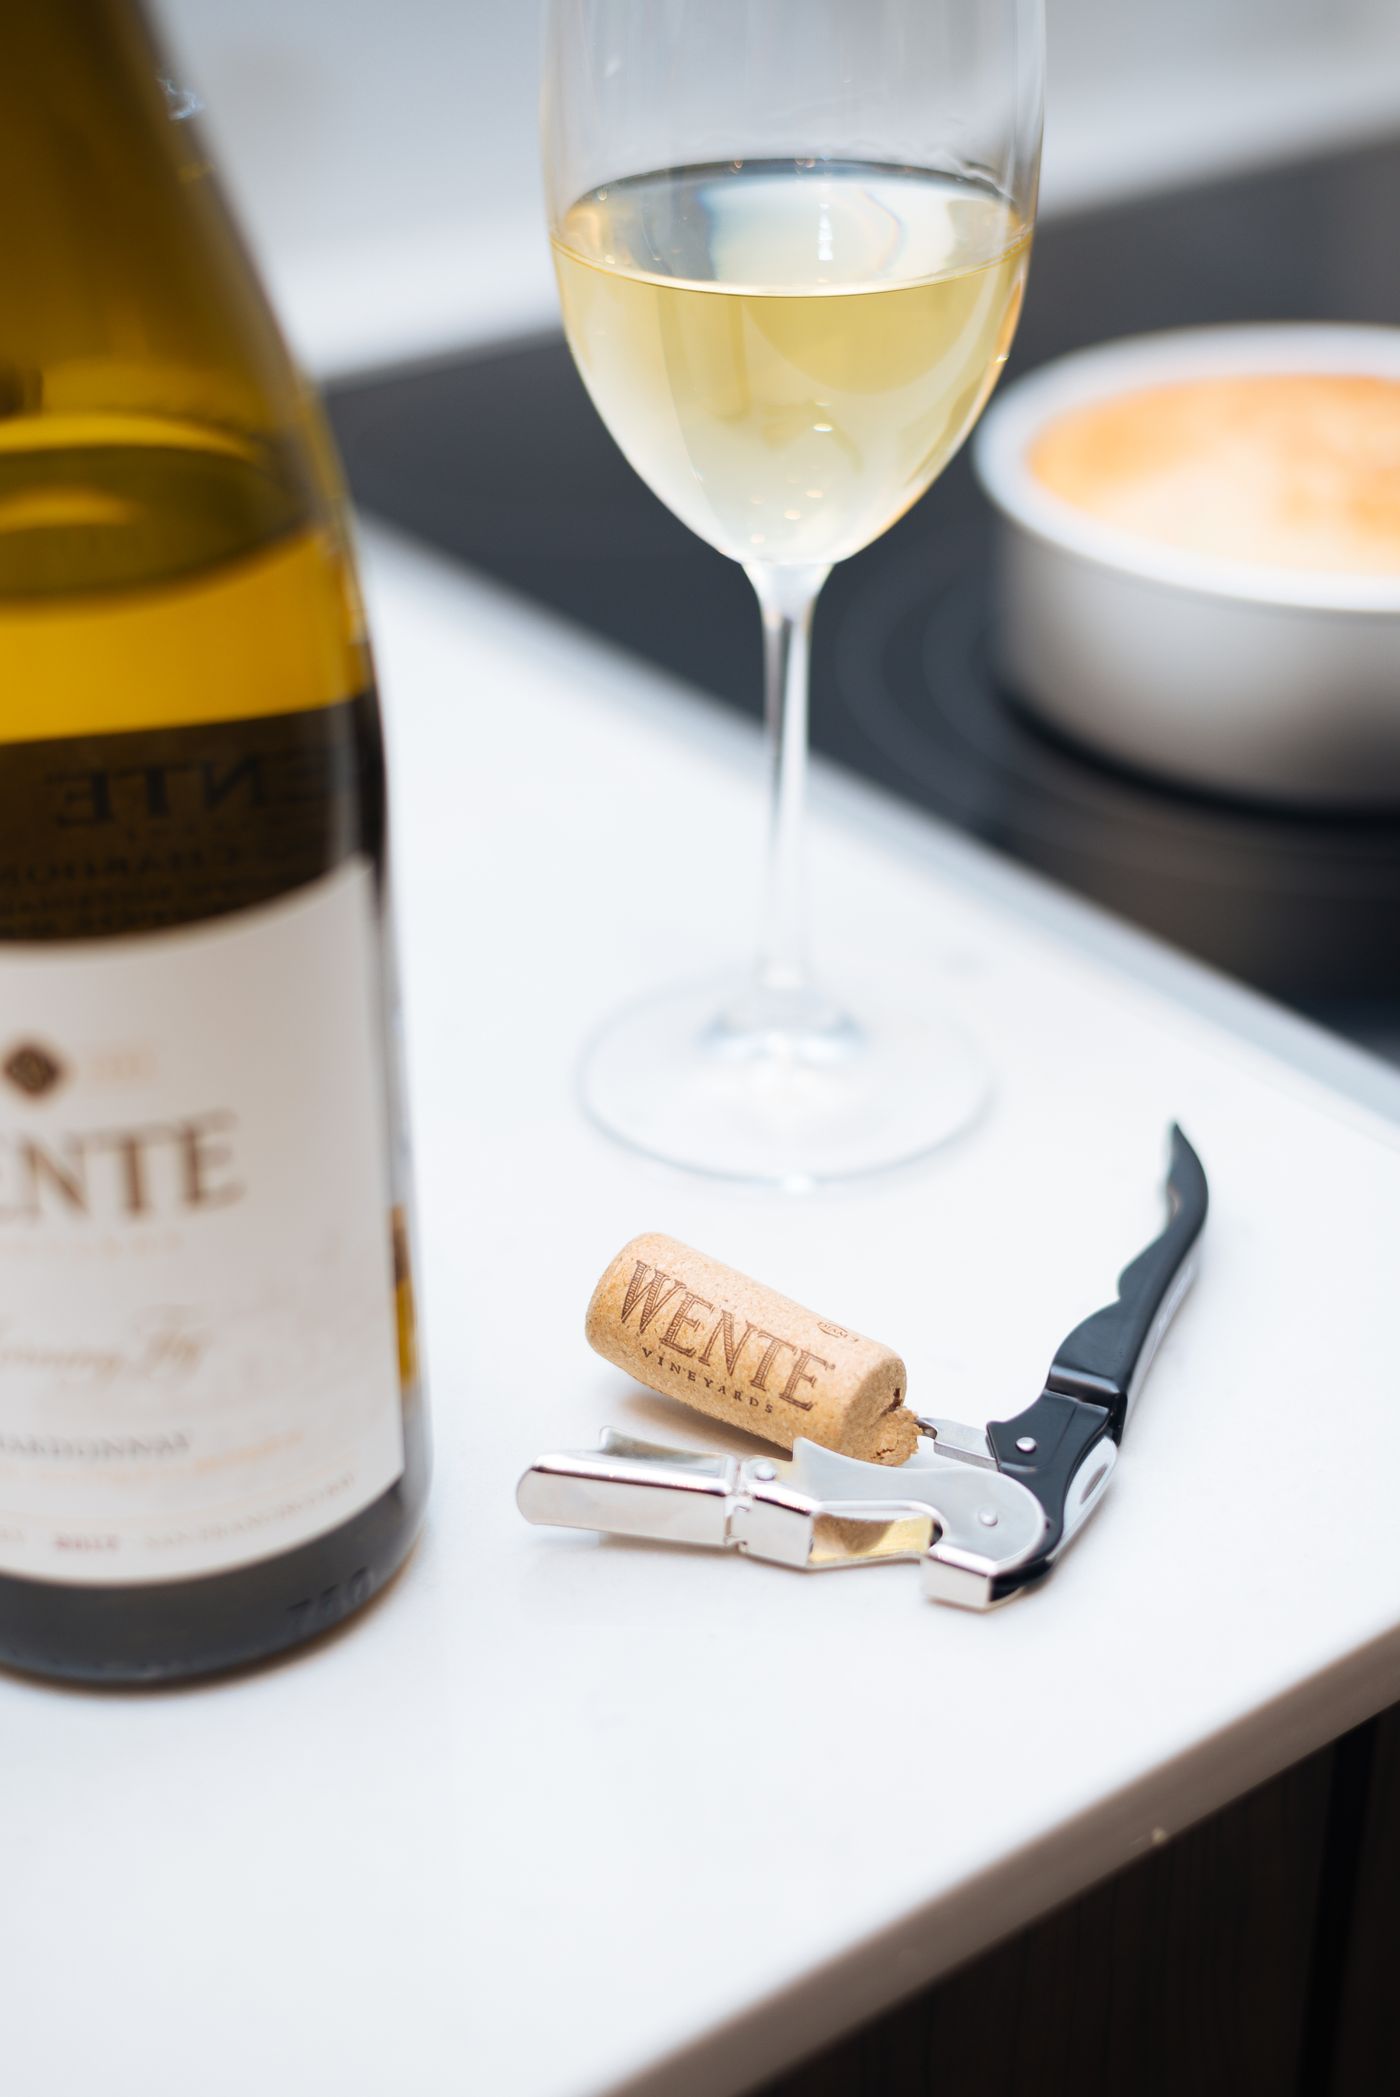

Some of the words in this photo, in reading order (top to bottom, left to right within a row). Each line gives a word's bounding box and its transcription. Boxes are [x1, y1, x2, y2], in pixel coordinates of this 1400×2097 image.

[0, 1105, 247, 1222] NTE
[620, 1259, 832, 1411] WENTE
[642, 1349, 774, 1414] VINEYARDS
